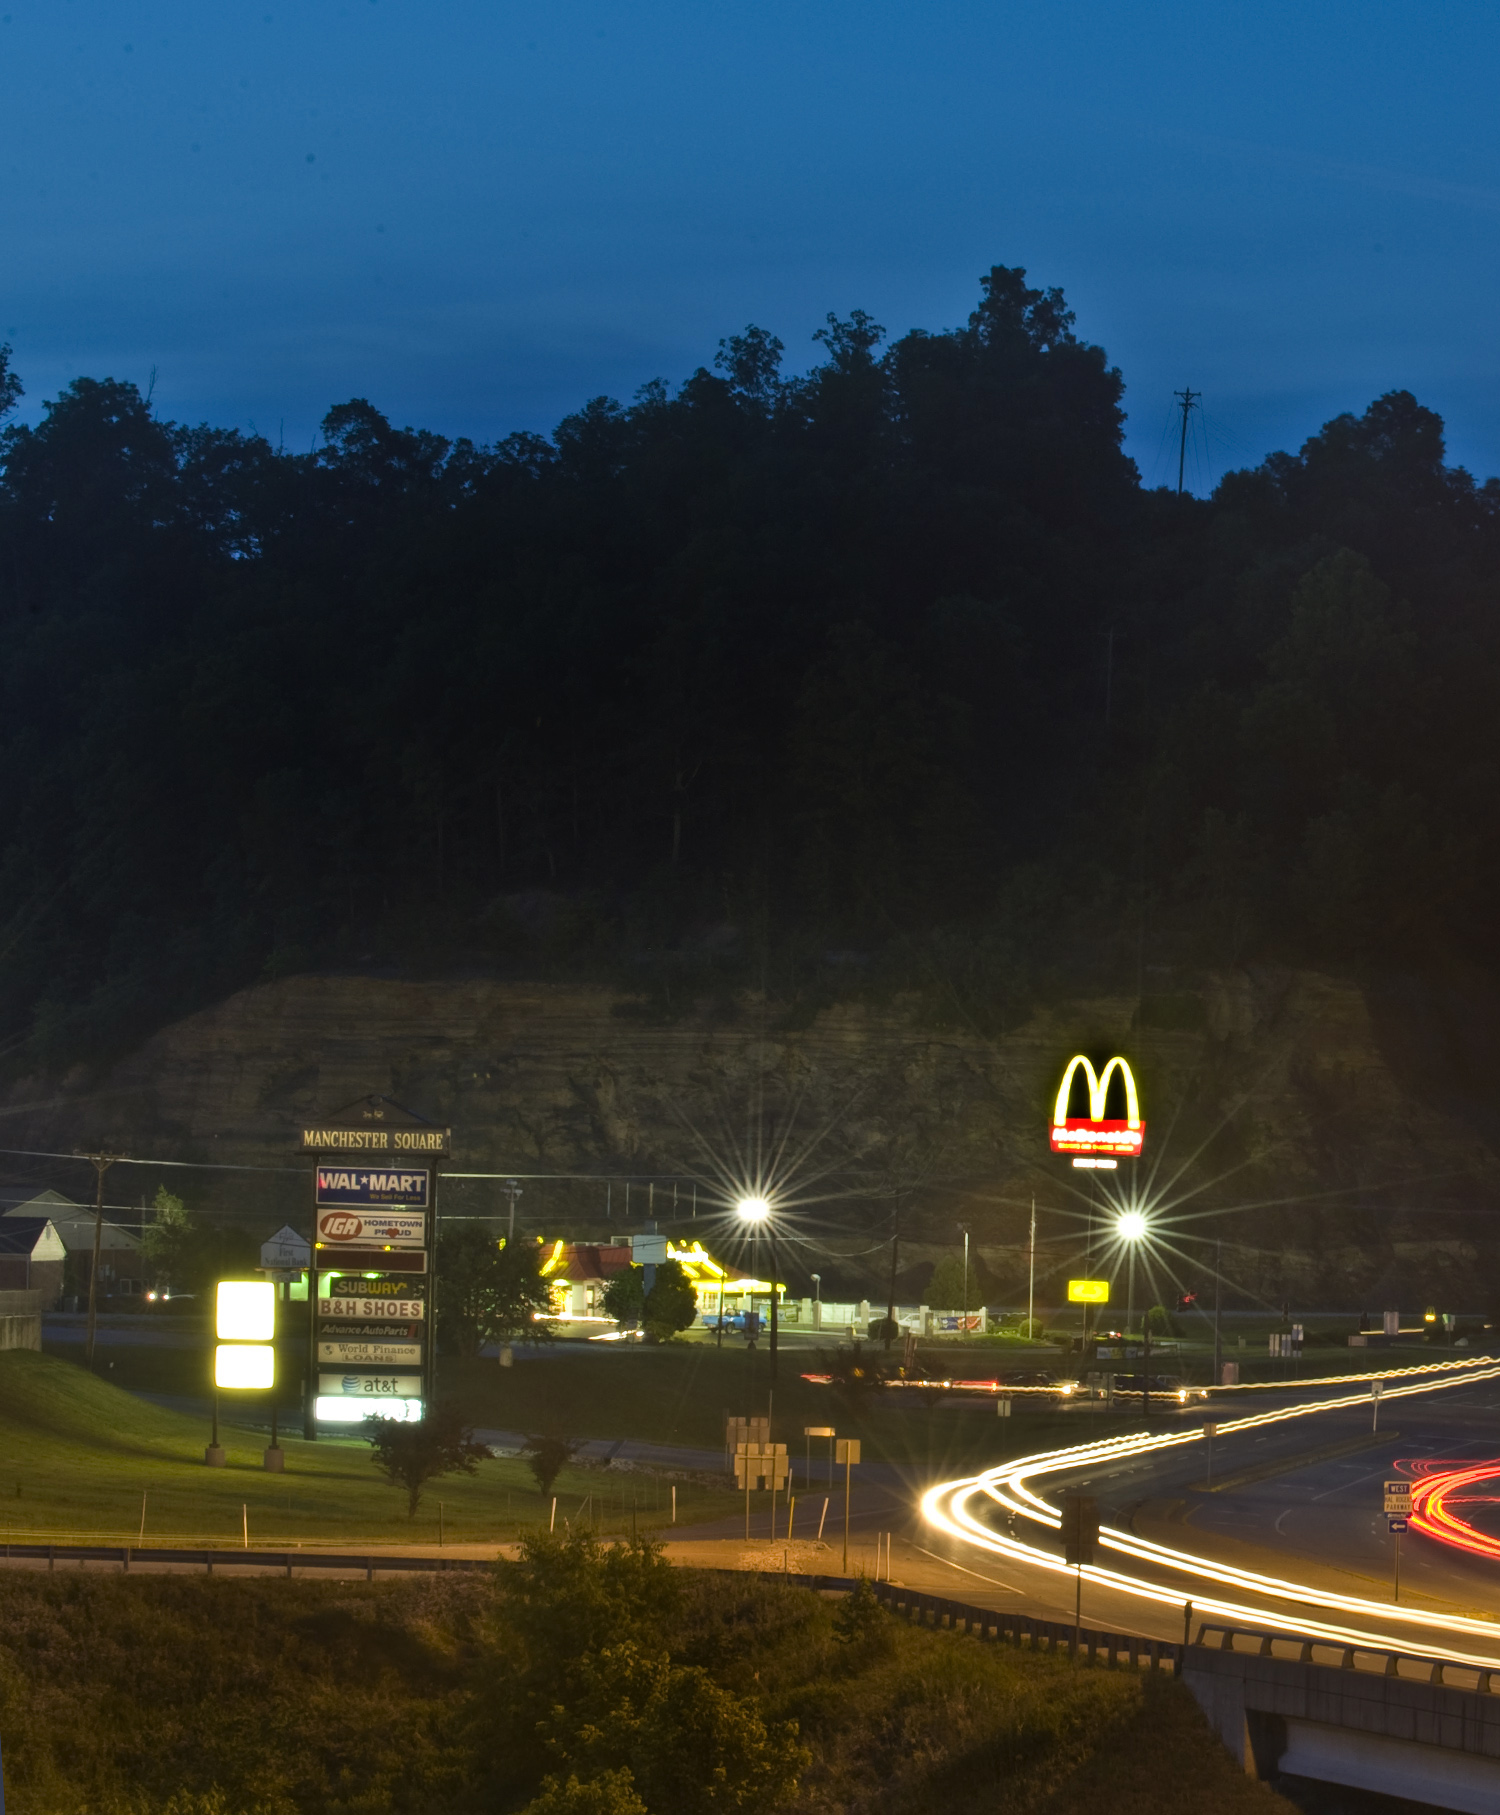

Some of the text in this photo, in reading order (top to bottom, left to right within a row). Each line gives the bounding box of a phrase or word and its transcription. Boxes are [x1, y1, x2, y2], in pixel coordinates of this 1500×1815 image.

[303, 1130, 444, 1150] MANCHESTER SQUARE
[323, 1218, 359, 1236] IGA
[364, 1220, 422, 1228] HOMETOWN
[335, 1281, 408, 1294] SUBWAY
[321, 1300, 420, 1316] B&H SHOES
[322, 1324, 360, 1334] Advance
[338, 1344, 416, 1355] World Finance
[364, 1376, 399, 1393] at&t
[1390, 1485, 1408, 1493] WEST
[1386, 1504, 1411, 1512] PARKWAY
